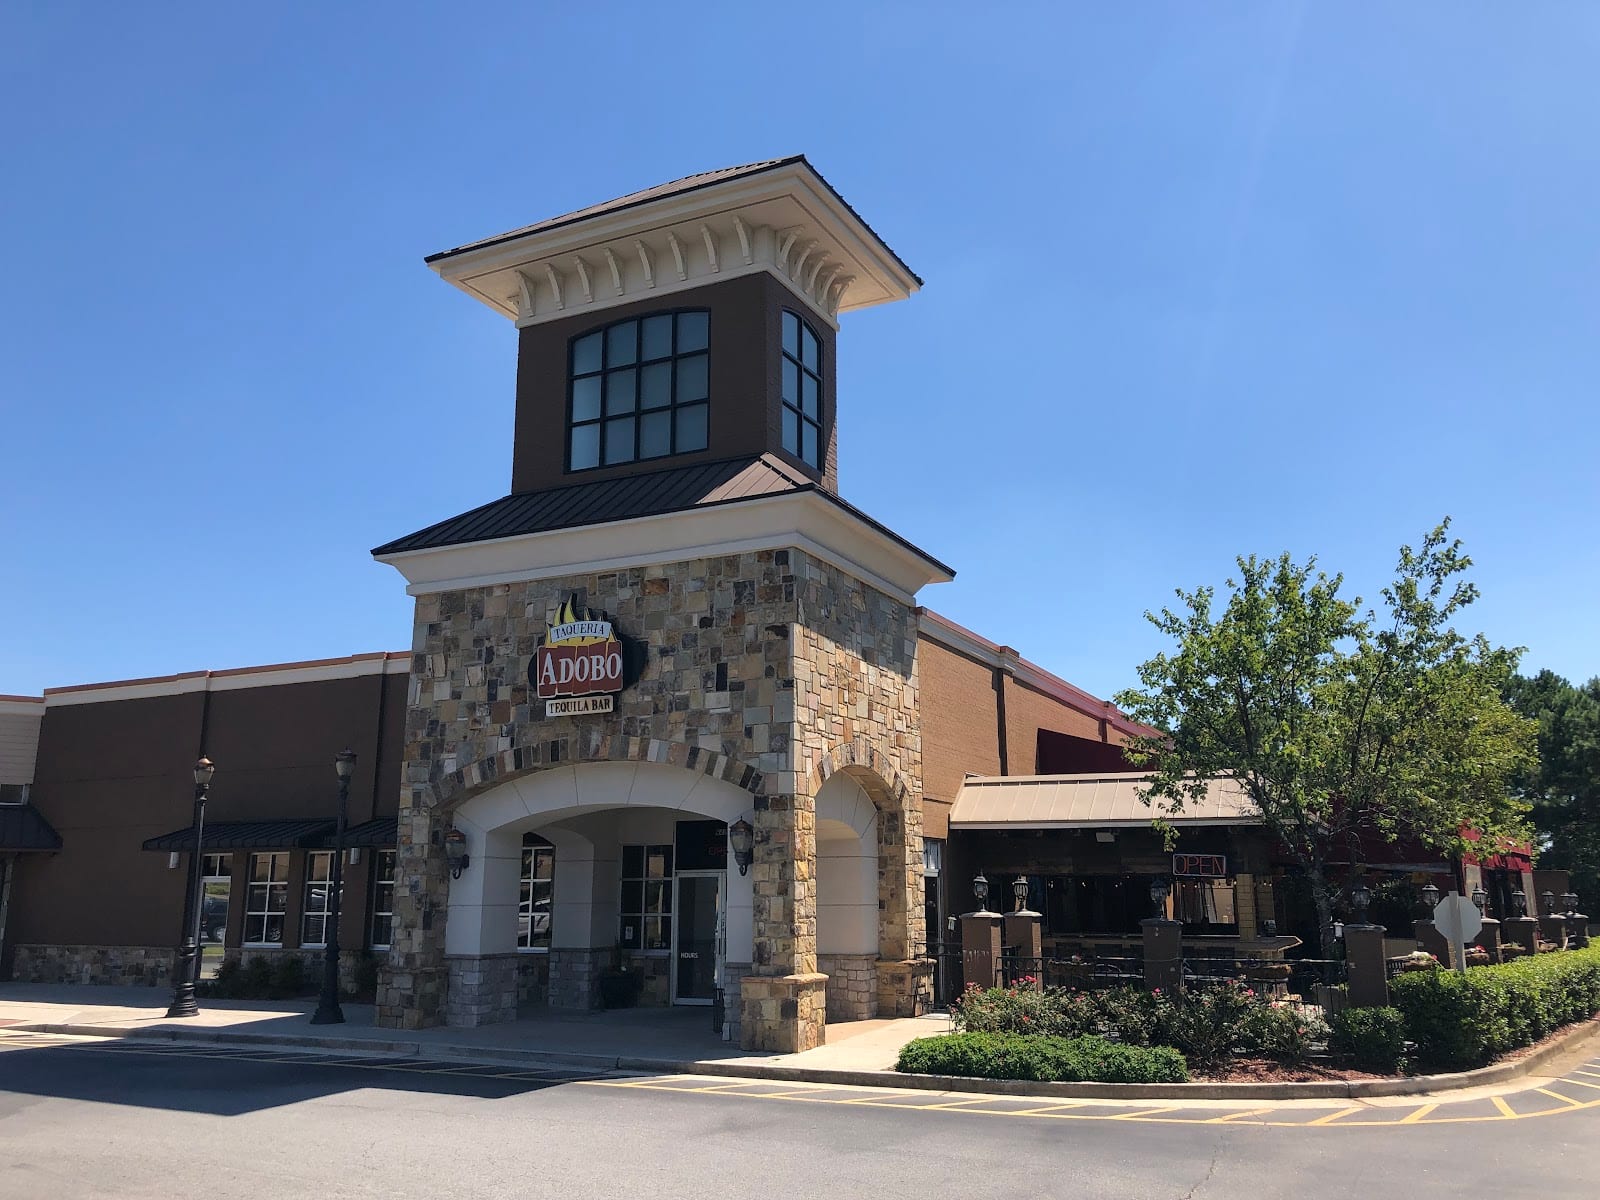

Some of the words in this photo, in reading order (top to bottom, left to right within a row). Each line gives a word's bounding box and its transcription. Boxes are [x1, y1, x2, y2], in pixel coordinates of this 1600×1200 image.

[554, 622, 605, 639] TAQUERIA
[540, 652, 622, 686] ADOBO
[548, 701, 589, 714] TEQUILA
[591, 698, 611, 711] BAR
[1175, 856, 1225, 875] OPEN
